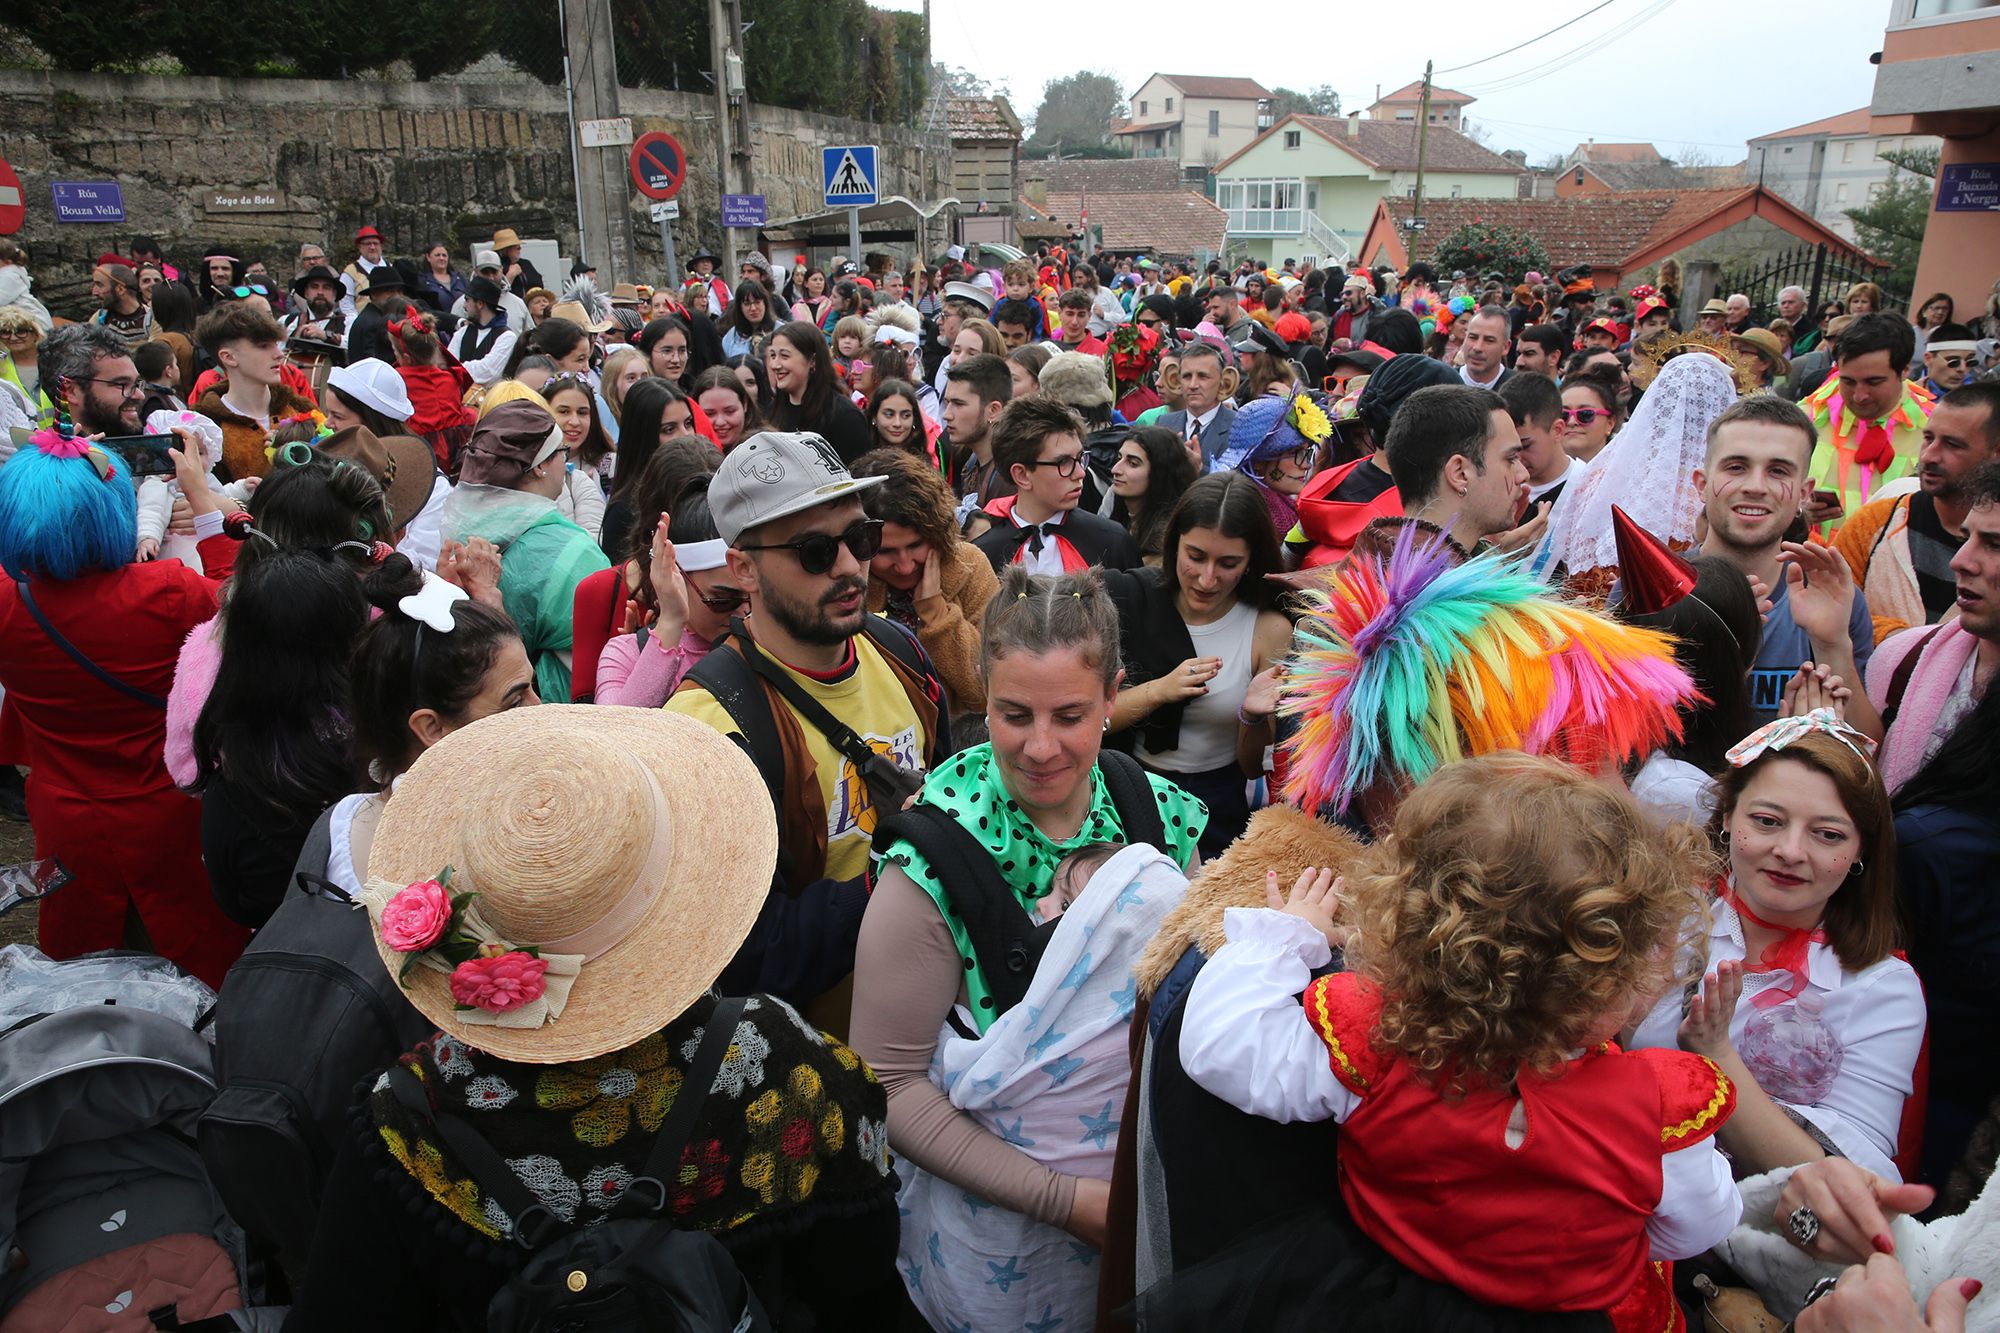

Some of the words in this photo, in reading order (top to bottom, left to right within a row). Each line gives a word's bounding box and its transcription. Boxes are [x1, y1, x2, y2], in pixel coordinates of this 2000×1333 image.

[78, 188, 98, 198] Rúa
[215, 195, 238, 207] Xogo
[240, 195, 252, 205] da
[254, 195, 275, 205] Bola
[1962, 192, 1998, 206] Nerga
[60, 205, 93, 216] Bouza
[94, 205, 122, 216] Vella
[728, 214, 738, 223] de
[738, 214, 760, 224] Nerga
